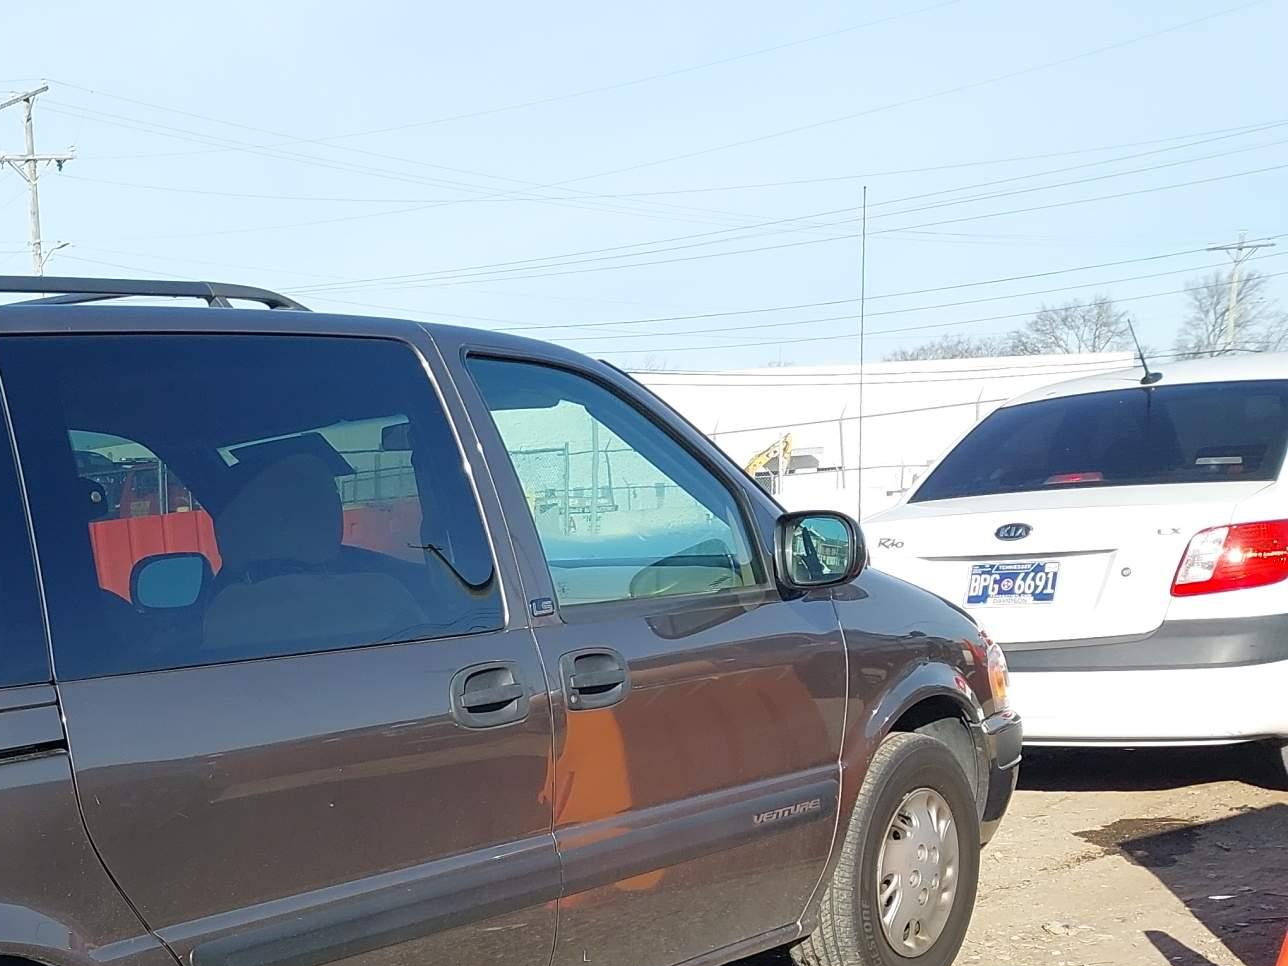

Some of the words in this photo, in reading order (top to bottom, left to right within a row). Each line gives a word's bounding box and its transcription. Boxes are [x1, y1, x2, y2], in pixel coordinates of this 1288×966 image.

[998, 525, 1027, 537] KIA
[878, 538, 904, 549] Rio
[968, 573, 1001, 596] BPG
[1014, 571, 1054, 594] 6691
[752, 799, 821, 825] VENTURE
